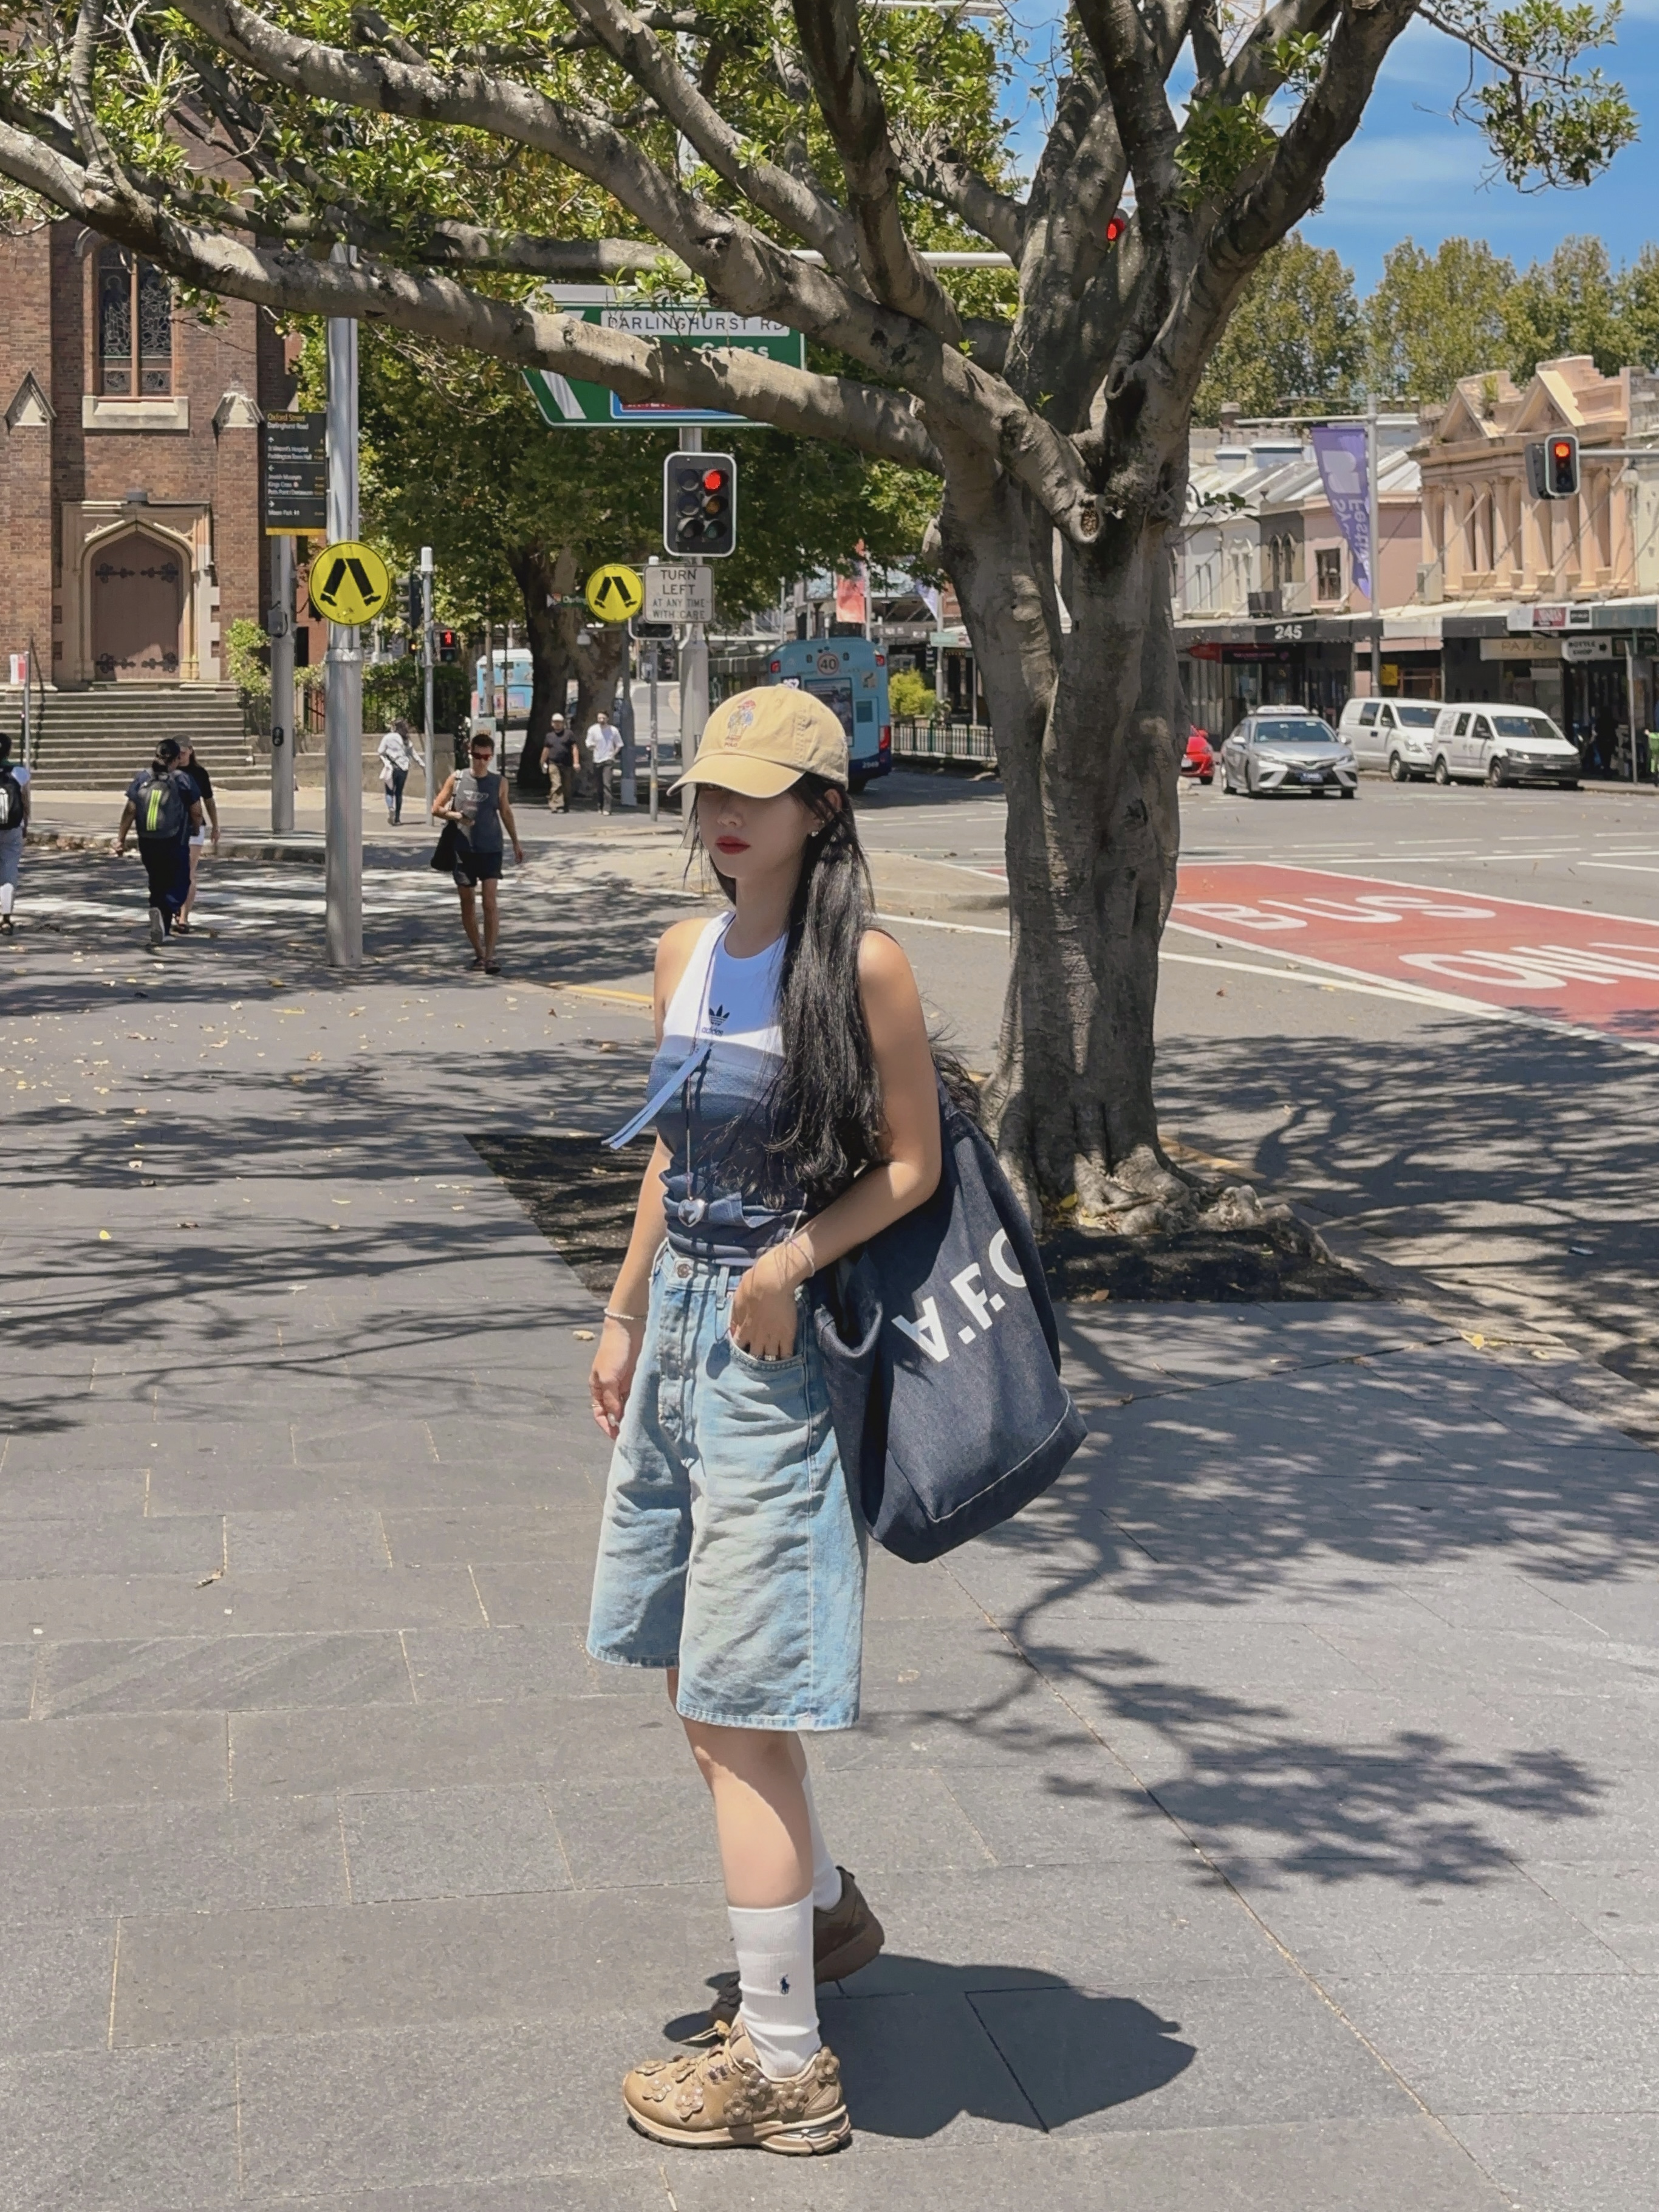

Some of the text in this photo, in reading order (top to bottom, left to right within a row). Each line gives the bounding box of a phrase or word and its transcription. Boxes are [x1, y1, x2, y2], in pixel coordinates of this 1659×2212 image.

[608, 317, 748, 330] DARLINGHURST
[661, 569, 697, 580] TURN
[663, 584, 696, 595] LEFT
[686, 598, 705, 607] TIME
[653, 610, 705, 619] WITH CARE
[1274, 624, 1302, 640] 245
[821, 659, 836, 669] 40
[1173, 895, 1497, 930] BUS
[702, 1026, 723, 1037] adidas
